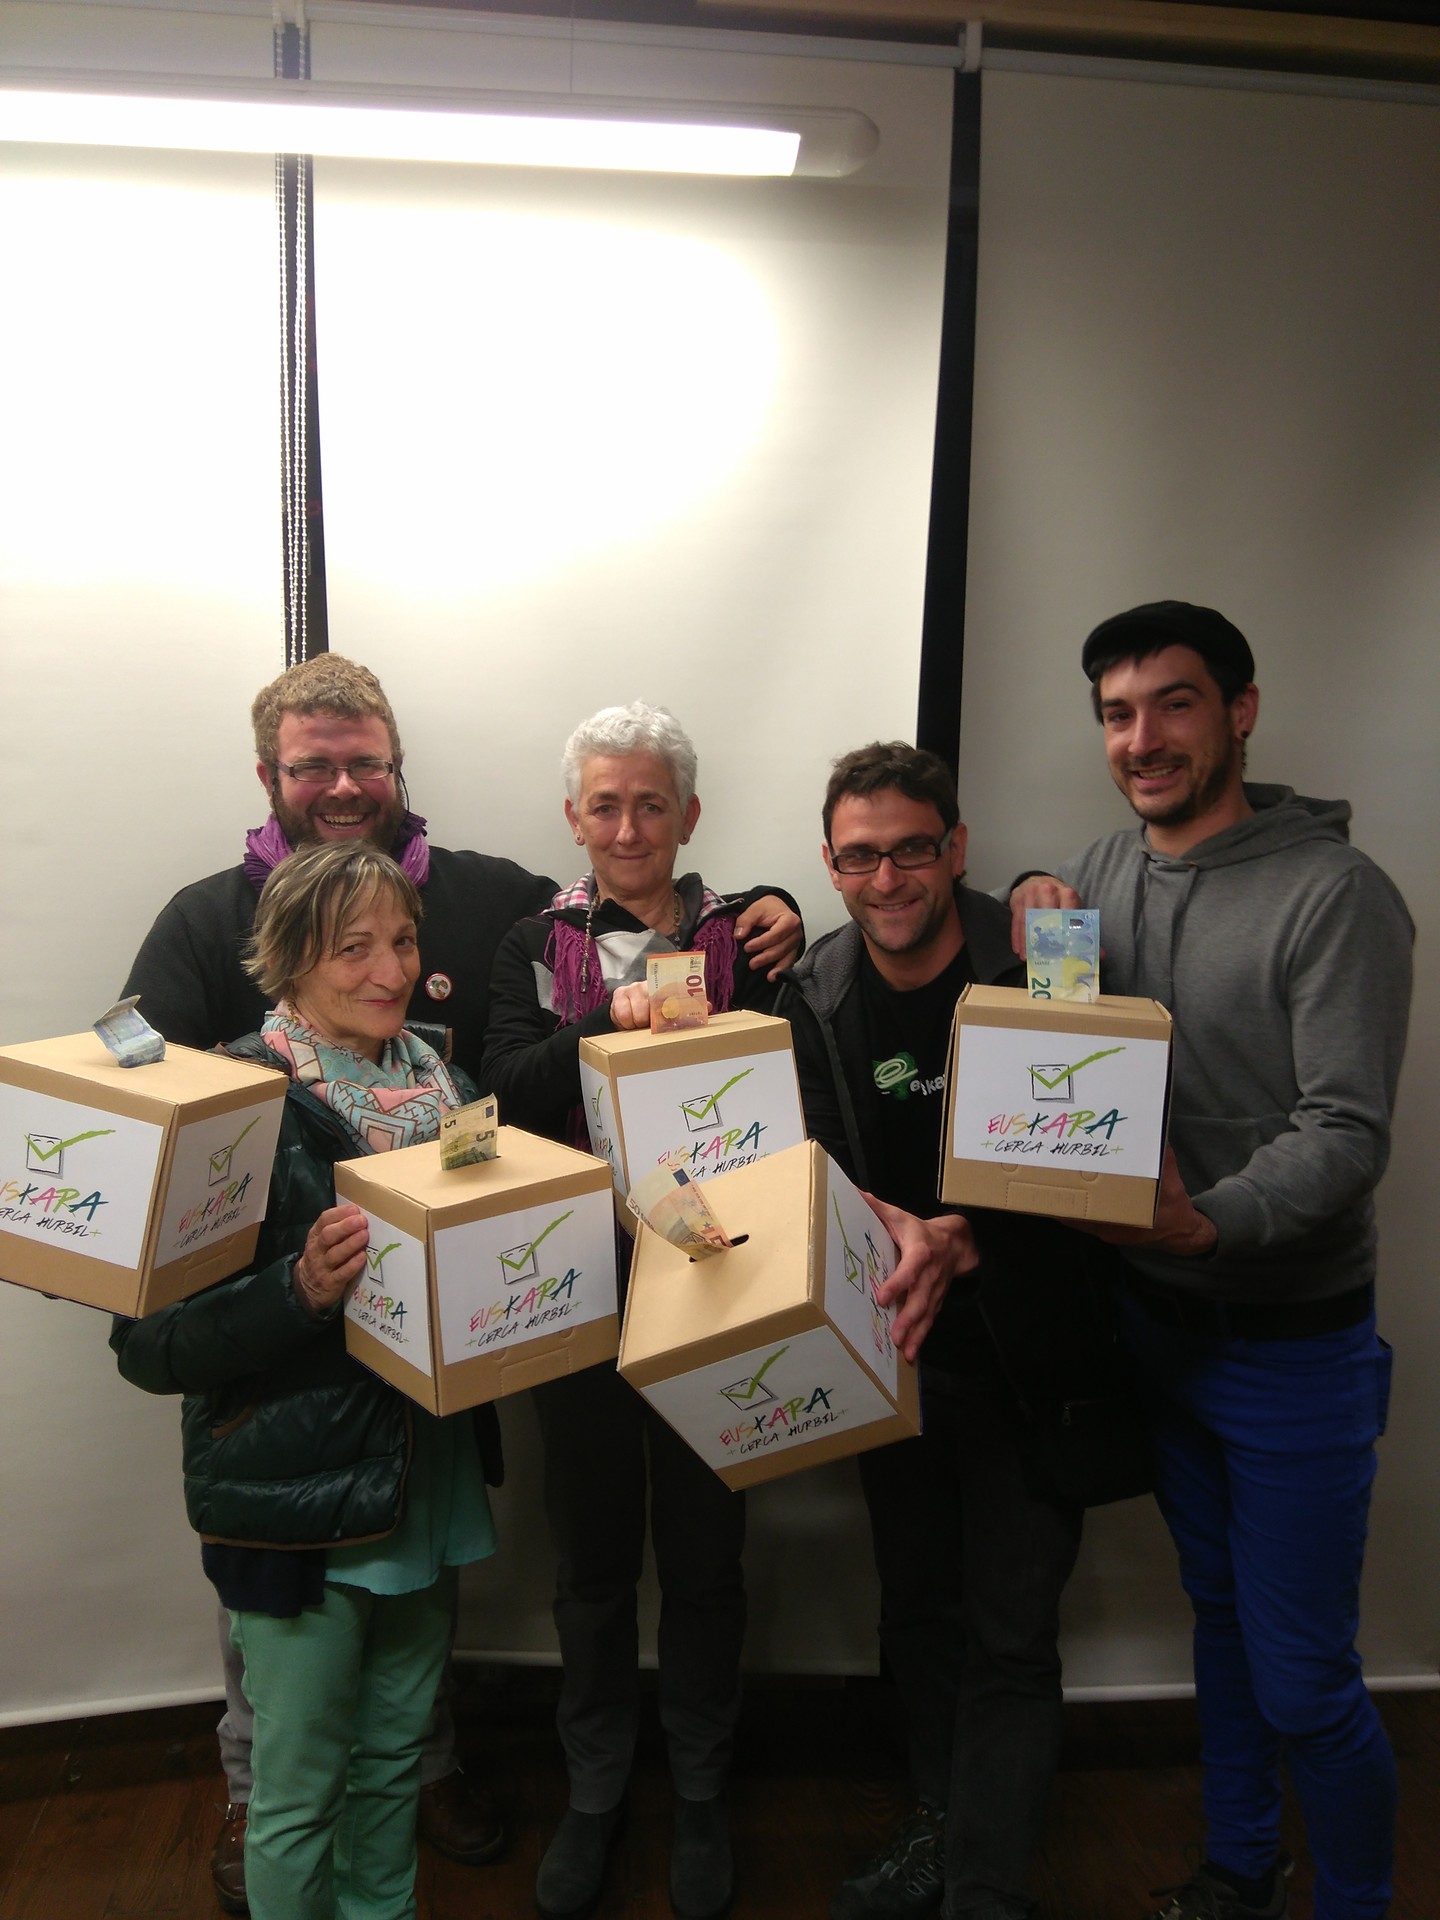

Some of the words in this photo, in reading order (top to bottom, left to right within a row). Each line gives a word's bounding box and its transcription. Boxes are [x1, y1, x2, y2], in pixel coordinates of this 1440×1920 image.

[685, 975, 703, 997] 10
[909, 1073, 945, 1096] elka
[444, 1119, 457, 1129] 5
[476, 1129, 495, 1143] 5
[988, 1109, 1128, 1140] EUSKARA
[657, 1121, 768, 1164] ESKARA
[0, 1181, 109, 1222] SKARA
[469, 1268, 582, 1333] EUSKARA
[719, 1387, 834, 1446] EUSKARA
